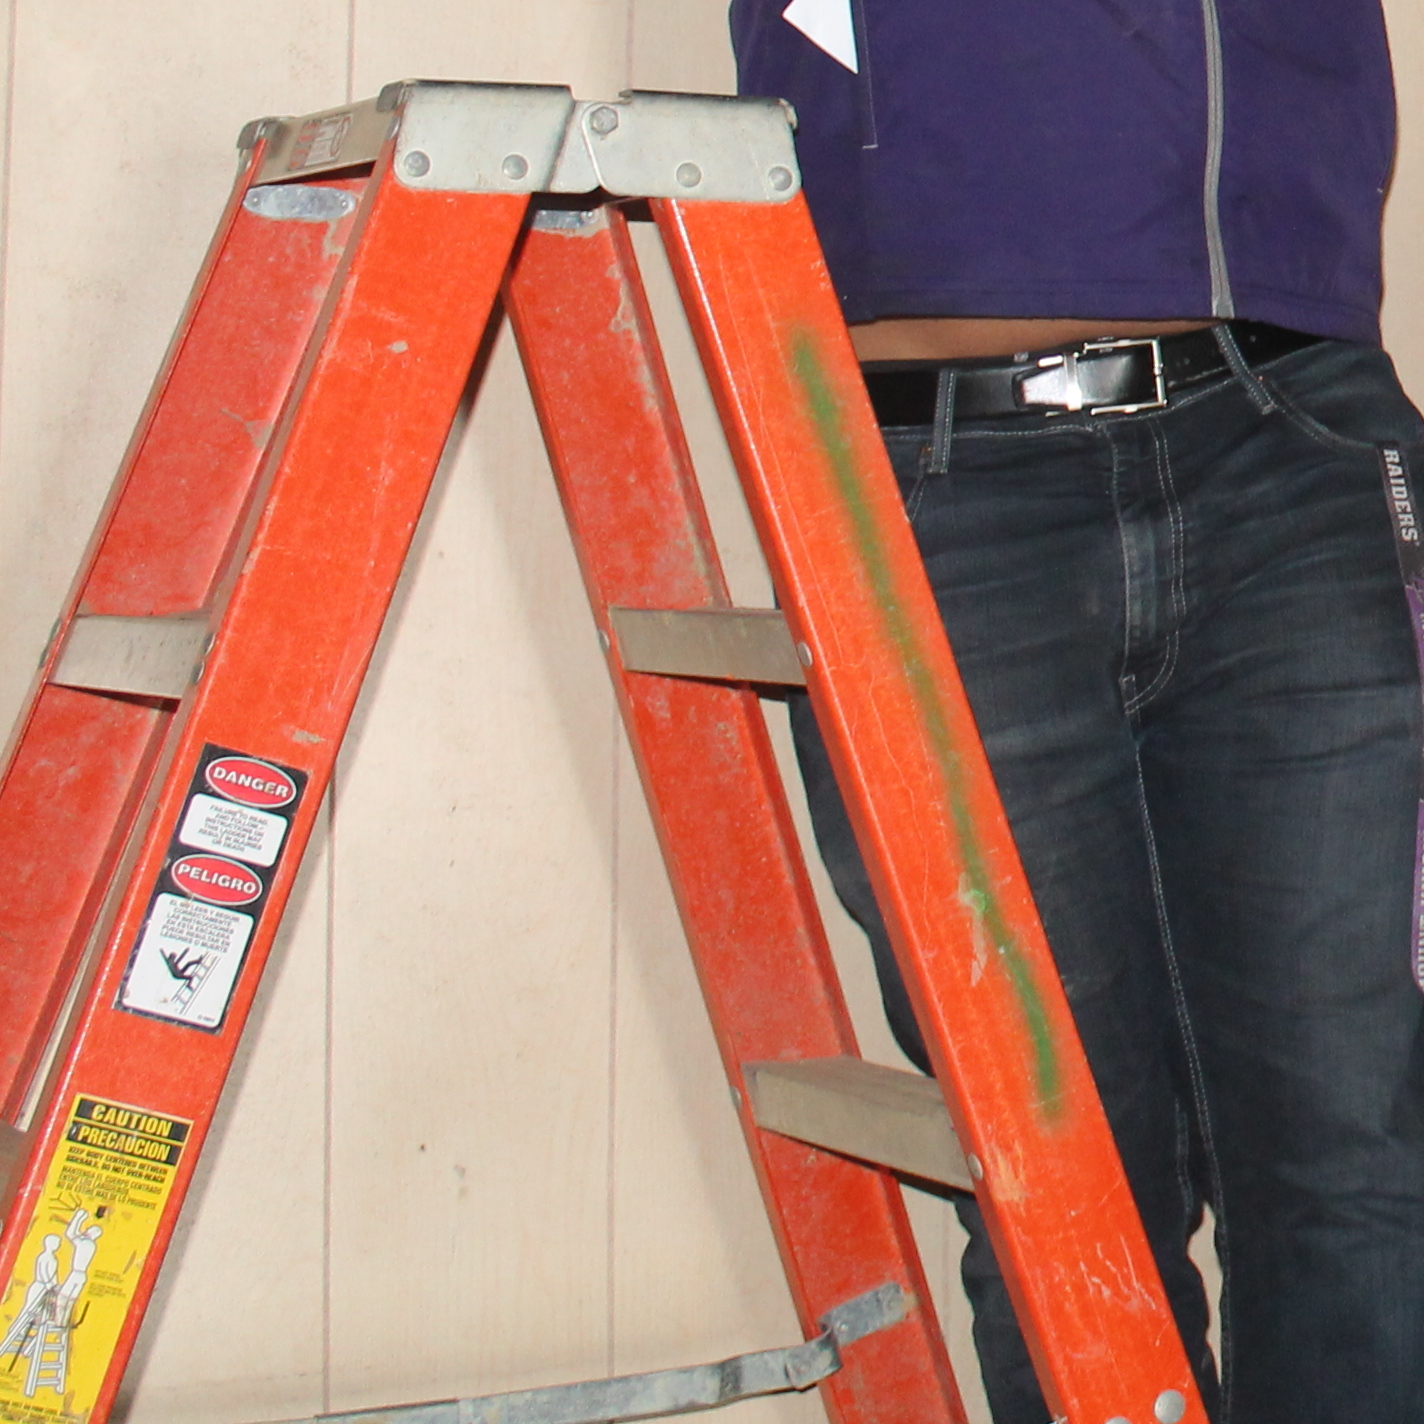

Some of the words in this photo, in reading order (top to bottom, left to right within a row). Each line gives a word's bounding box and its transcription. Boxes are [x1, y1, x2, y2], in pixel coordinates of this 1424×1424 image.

[1384, 448, 1419, 544] RAIDERS
[212, 765, 289, 797] DANGER
[177, 864, 256, 895] PELIGRO
[91, 1103, 173, 1137] CAUTION
[77, 1125, 171, 1161] PRECAUCION
